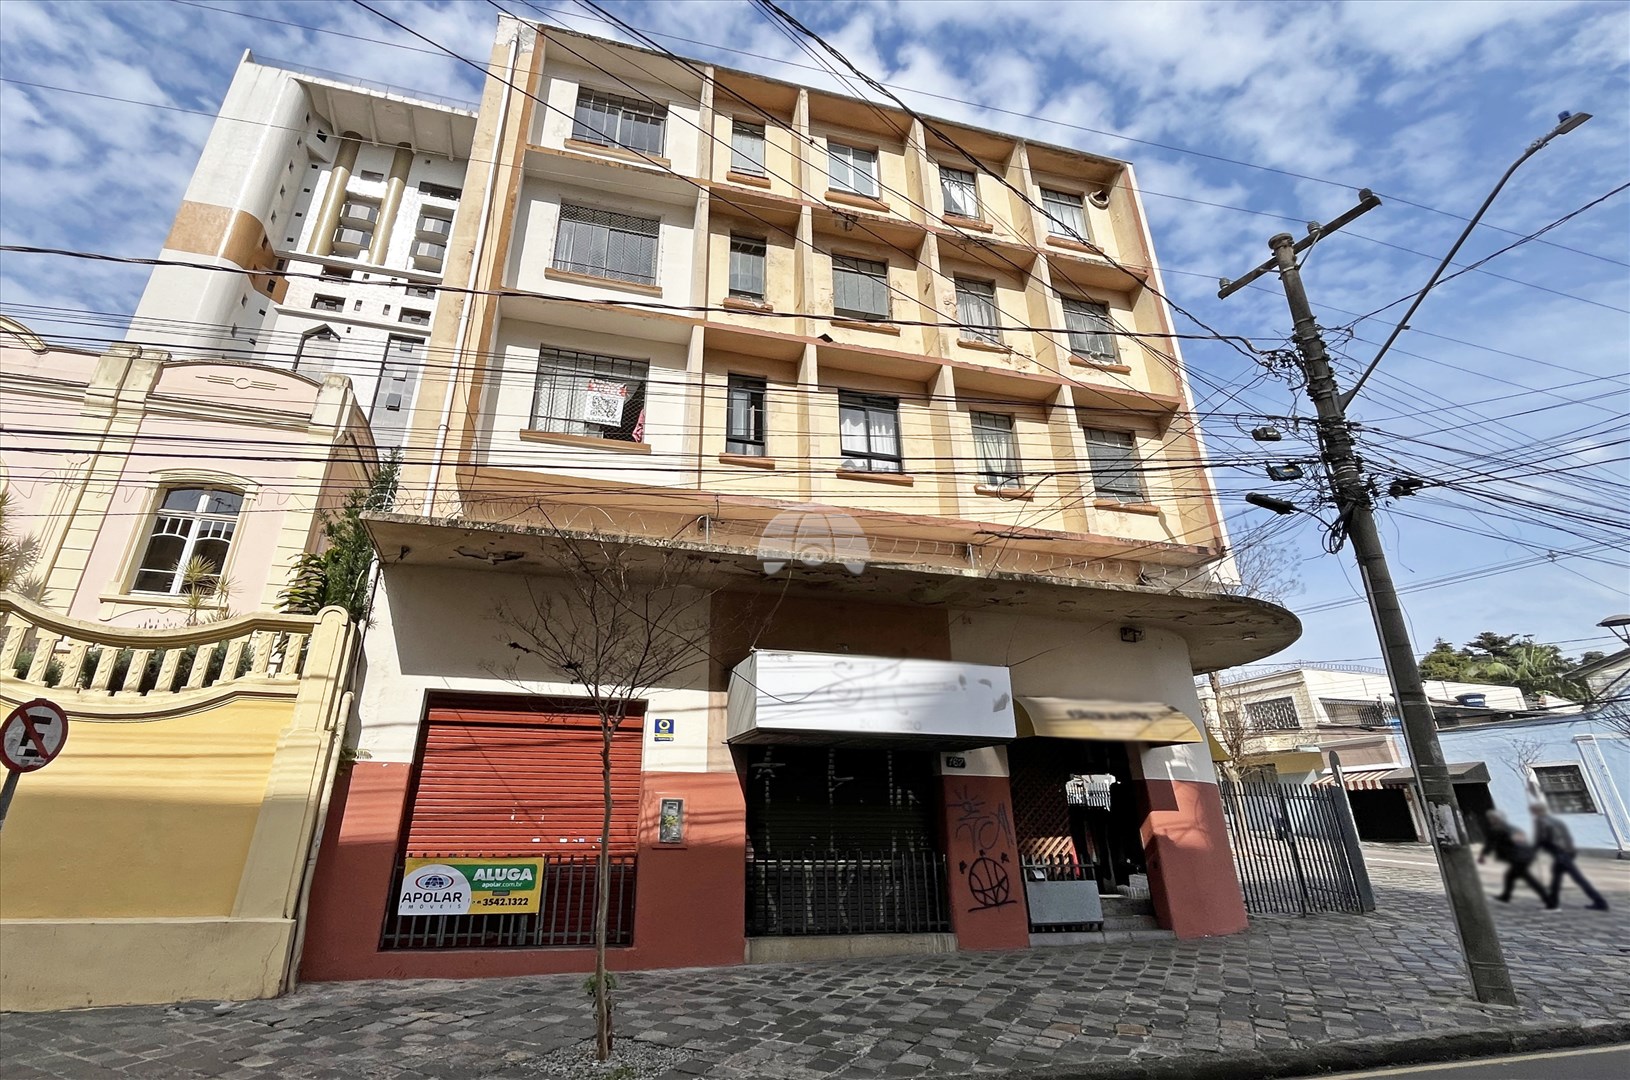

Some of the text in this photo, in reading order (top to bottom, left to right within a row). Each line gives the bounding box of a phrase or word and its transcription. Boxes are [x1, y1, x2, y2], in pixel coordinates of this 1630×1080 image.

[472, 868, 533, 881] ALUGA
[401, 892, 462, 903] APOLAR
[482, 898, 528, 906] 3542.1322
